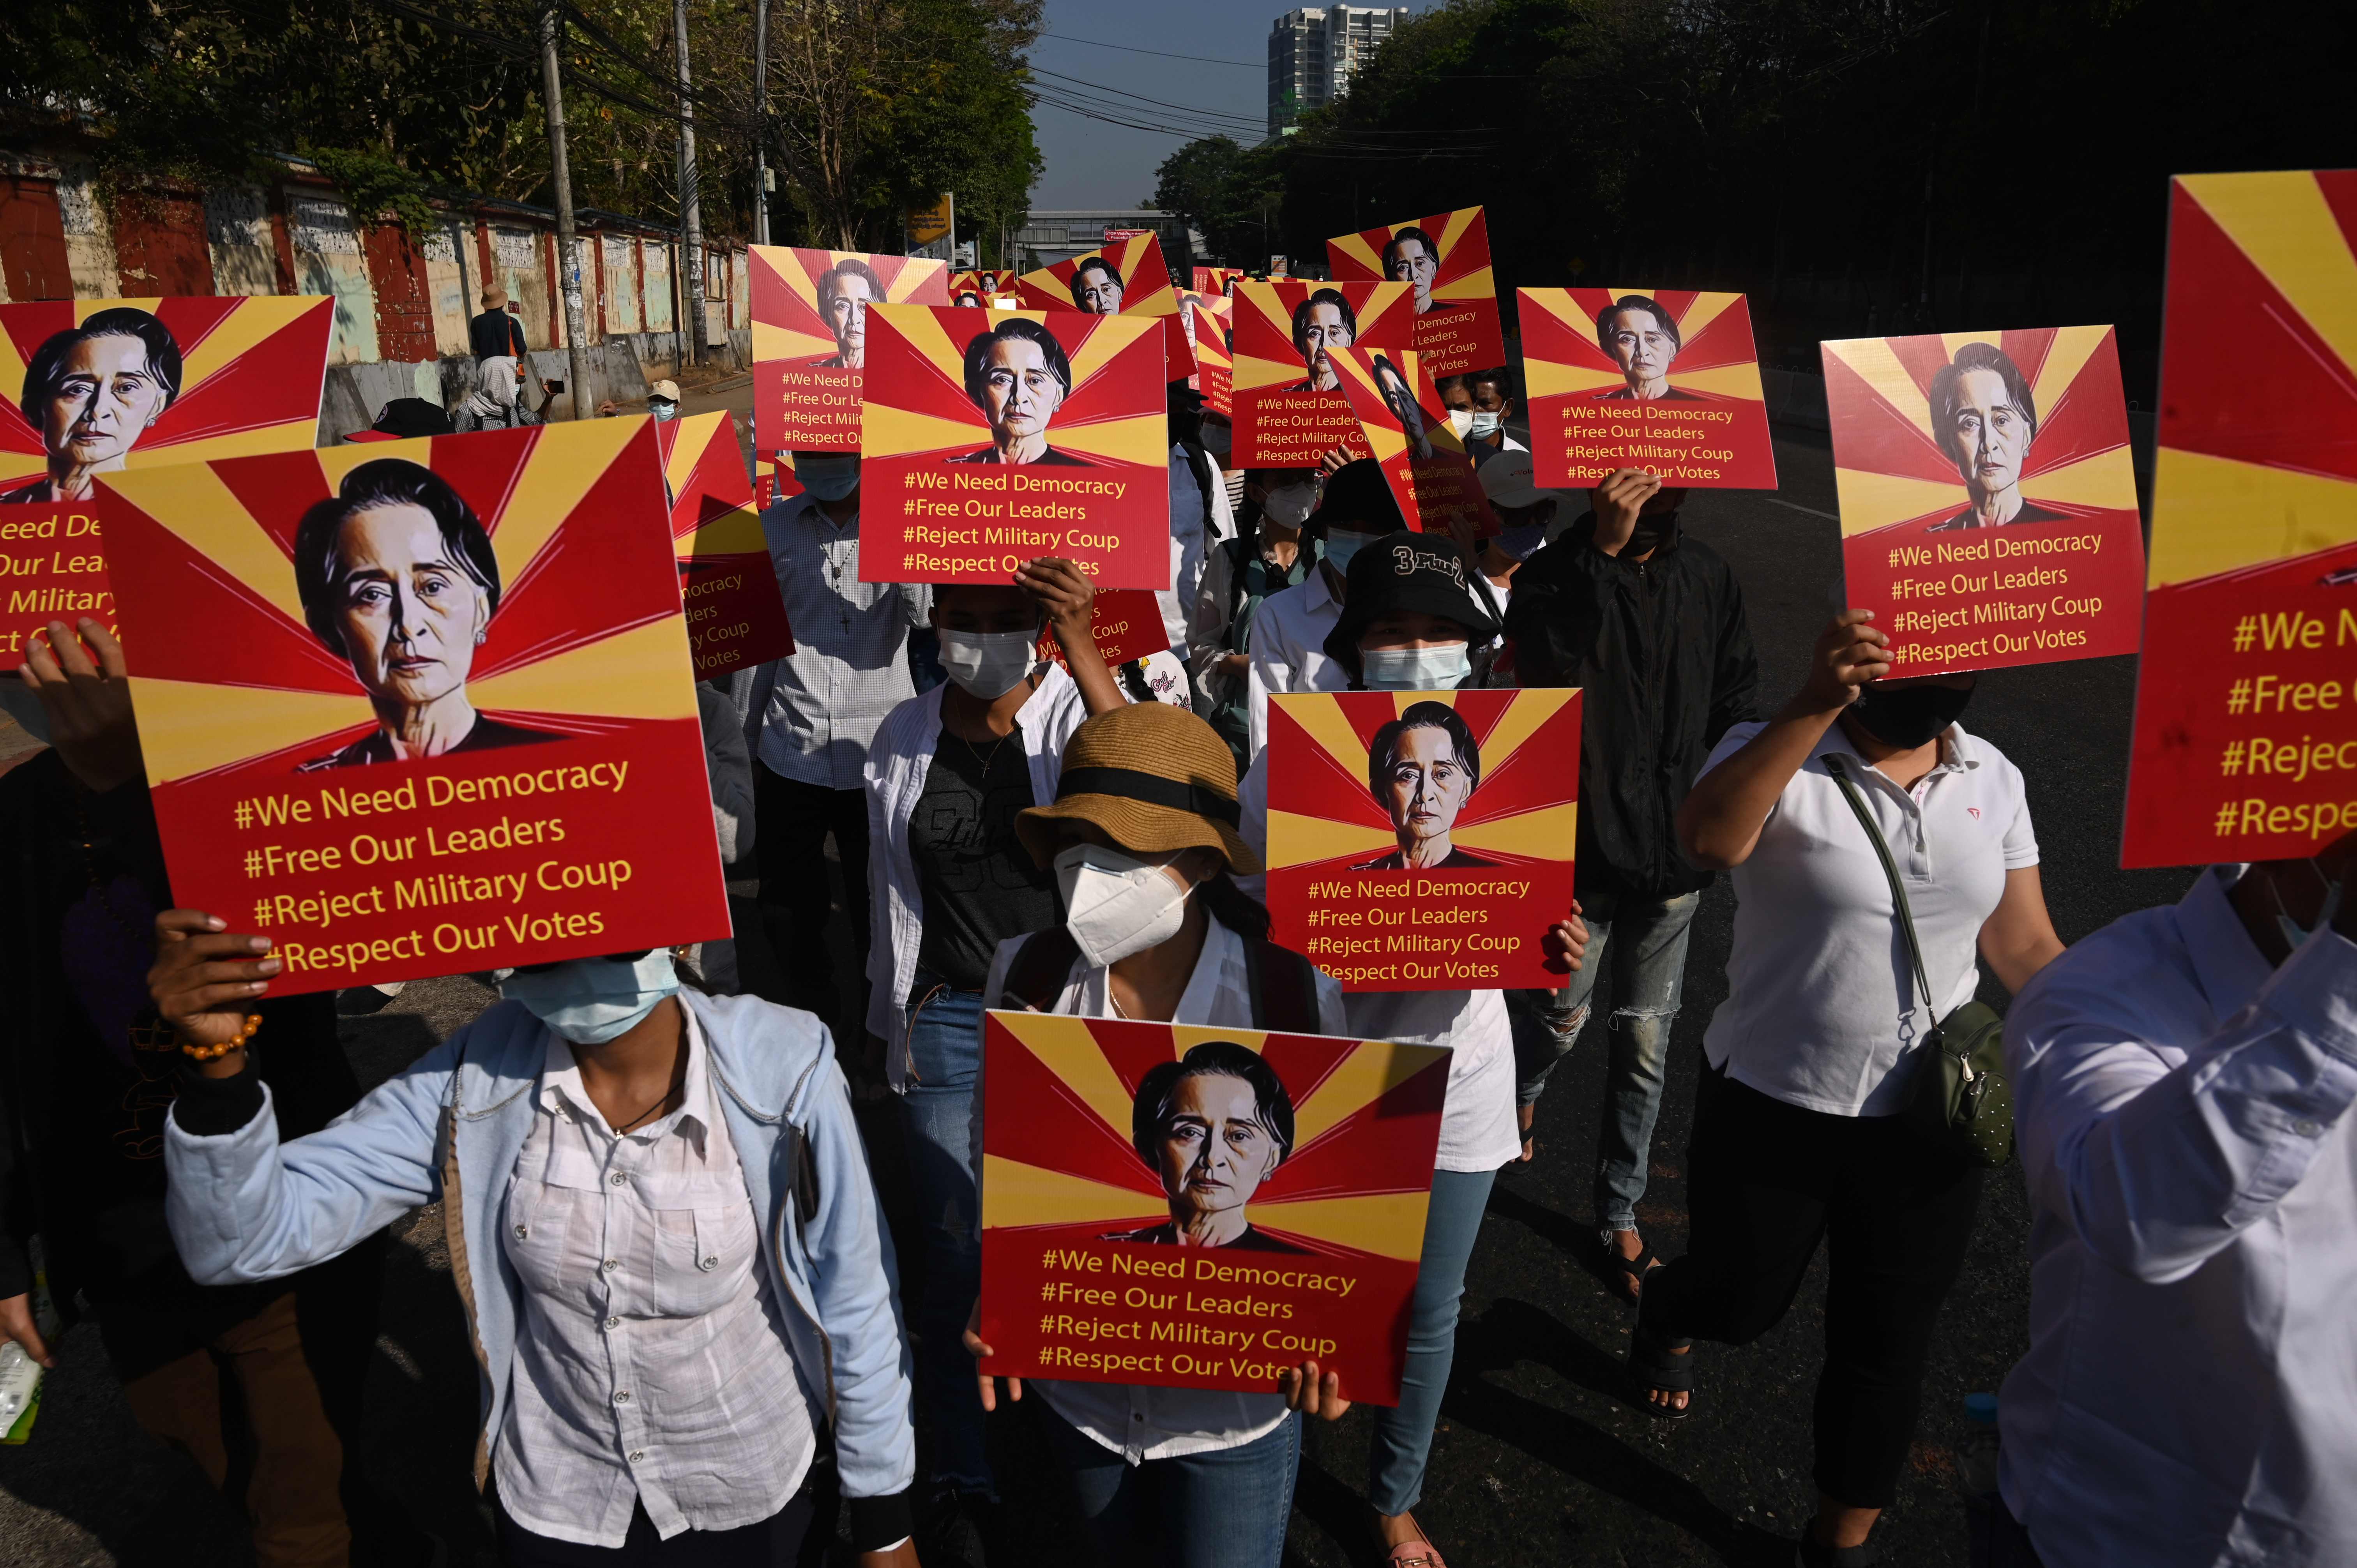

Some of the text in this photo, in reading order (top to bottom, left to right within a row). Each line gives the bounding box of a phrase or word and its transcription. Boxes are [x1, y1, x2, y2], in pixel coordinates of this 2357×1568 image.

[1418, 312, 1475, 330] Democracy
[1418, 331, 1457, 345] Leaders
[1449, 343, 1476, 353] Coup
[1440, 360, 1468, 371] Votes
[783, 373, 811, 385] #We
[815, 374, 848, 387] Need
[1212, 371, 1224, 381] #We
[1212, 381, 1228, 392] #Free
[783, 392, 818, 404] #Free
[823, 393, 846, 405] Our
[1213, 390, 1232, 404] #Rejec
[1214, 401, 1232, 413] #Resp
[1257, 399, 1282, 409] #We
[1286, 398, 1316, 409] Need
[784, 411, 862, 426] #Reject Milit
[1257, 416, 1288, 426] #Free
[1292, 416, 1313, 426] Our
[1562, 406, 1732, 424] #We Need Democracy
[784, 430, 843, 445] #Respect
[1256, 433, 1299, 446] #Reject
[1303, 432, 1346, 445] Military
[1564, 426, 1704, 439] #Free Our Leaders
[1256, 450, 1308, 463] #Respect
[1566, 445, 1733, 462] #Reject Military Coup
[1399, 466, 1465, 481] #We Need Democracy
[1644, 464, 1673, 478] Our
[1677, 466, 1720, 479] Votes
[905, 472, 1125, 499] #We Need Democracy
[1408, 483, 1462, 500] #Free Our Leaders
[904, 499, 1085, 519] #Free Our Leaders
[1417, 507, 1442, 521] #Reject
[1462, 501, 1478, 514] Coup
[1, 515, 57, 539] eed
[1471, 521, 1481, 530] tes
[904, 526, 1119, 552] #Reject Military Coup
[1889, 535, 2101, 567] #We Need Democracy
[903, 554, 996, 575] #Respect
[1393, 546, 1465, 590] 3 Plus 2
[1892, 566, 2067, 600] #Free Our Leaders
[686, 606, 717, 624] ders
[1894, 596, 2102, 634] #Reject Military Coup
[707, 622, 749, 642] Coup
[1091, 621, 1128, 640] Coup
[2234, 611, 2325, 652] #We
[1100, 646, 1120, 659] tes
[1896, 630, 2086, 664] #Respect Our Votes
[695, 649, 740, 670] Votes
[1150, 671, 1168, 692] Girl
[2228, 676, 2342, 714] #Free
[2221, 736, 2357, 782] #Rejec
[235, 761, 628, 829] #We Need Democracy
[2215, 799, 2357, 839] #Respe
[244, 817, 565, 878] #Free Our Leaders
[254, 860, 631, 927] #Reject Military Coup
[1308, 879, 1530, 899] #We Need Democracy
[1308, 906, 1487, 926] #Free Our Leaders
[433, 923, 498, 953] Our
[504, 912, 604, 943] Votes
[1307, 934, 1520, 957] #Reject Military Coup
[1315, 962, 1498, 984] Respect Our Votes
[1042, 1250, 1356, 1296] #We Need Democracy
[1041, 1283, 1292, 1318] #Free Our Leaders
[1040, 1315, 1336, 1357] #Reject Military Coup
[1039, 1347, 1291, 1381] #Respect Our Vote
